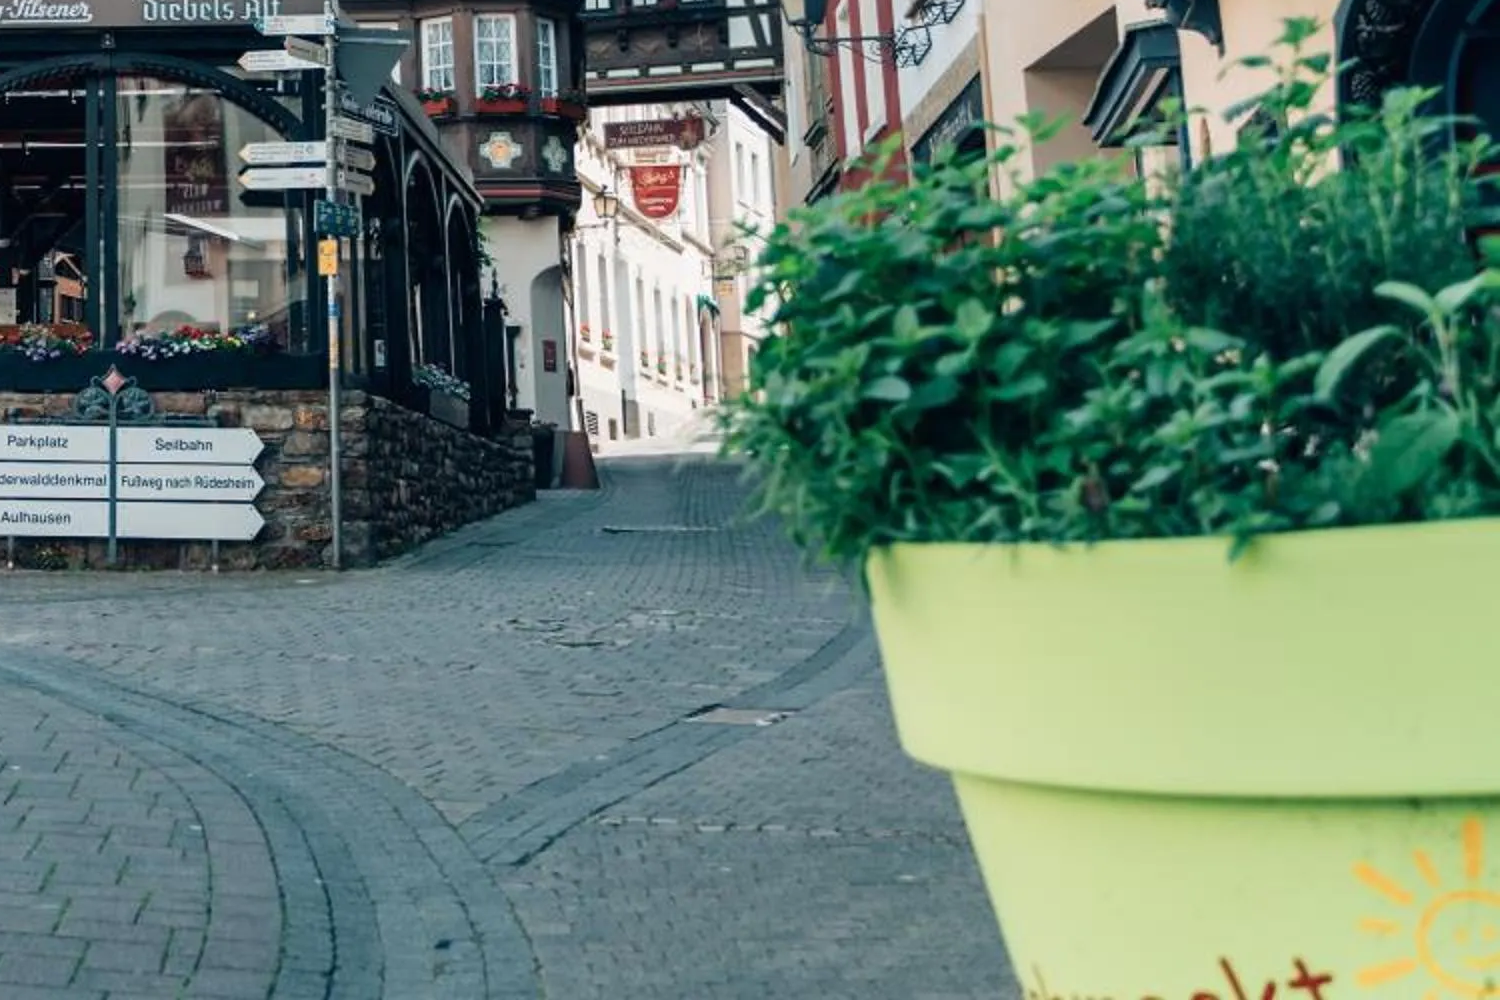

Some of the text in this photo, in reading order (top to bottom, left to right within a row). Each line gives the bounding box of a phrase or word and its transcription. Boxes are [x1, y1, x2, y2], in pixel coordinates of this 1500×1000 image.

[7, 434, 69, 449] Parkplatz
[155, 437, 213, 451] Seilbahn
[121, 475, 255, 490] Fußweg nach Rüdesheim
[1, 511, 71, 525] Aulhausen
